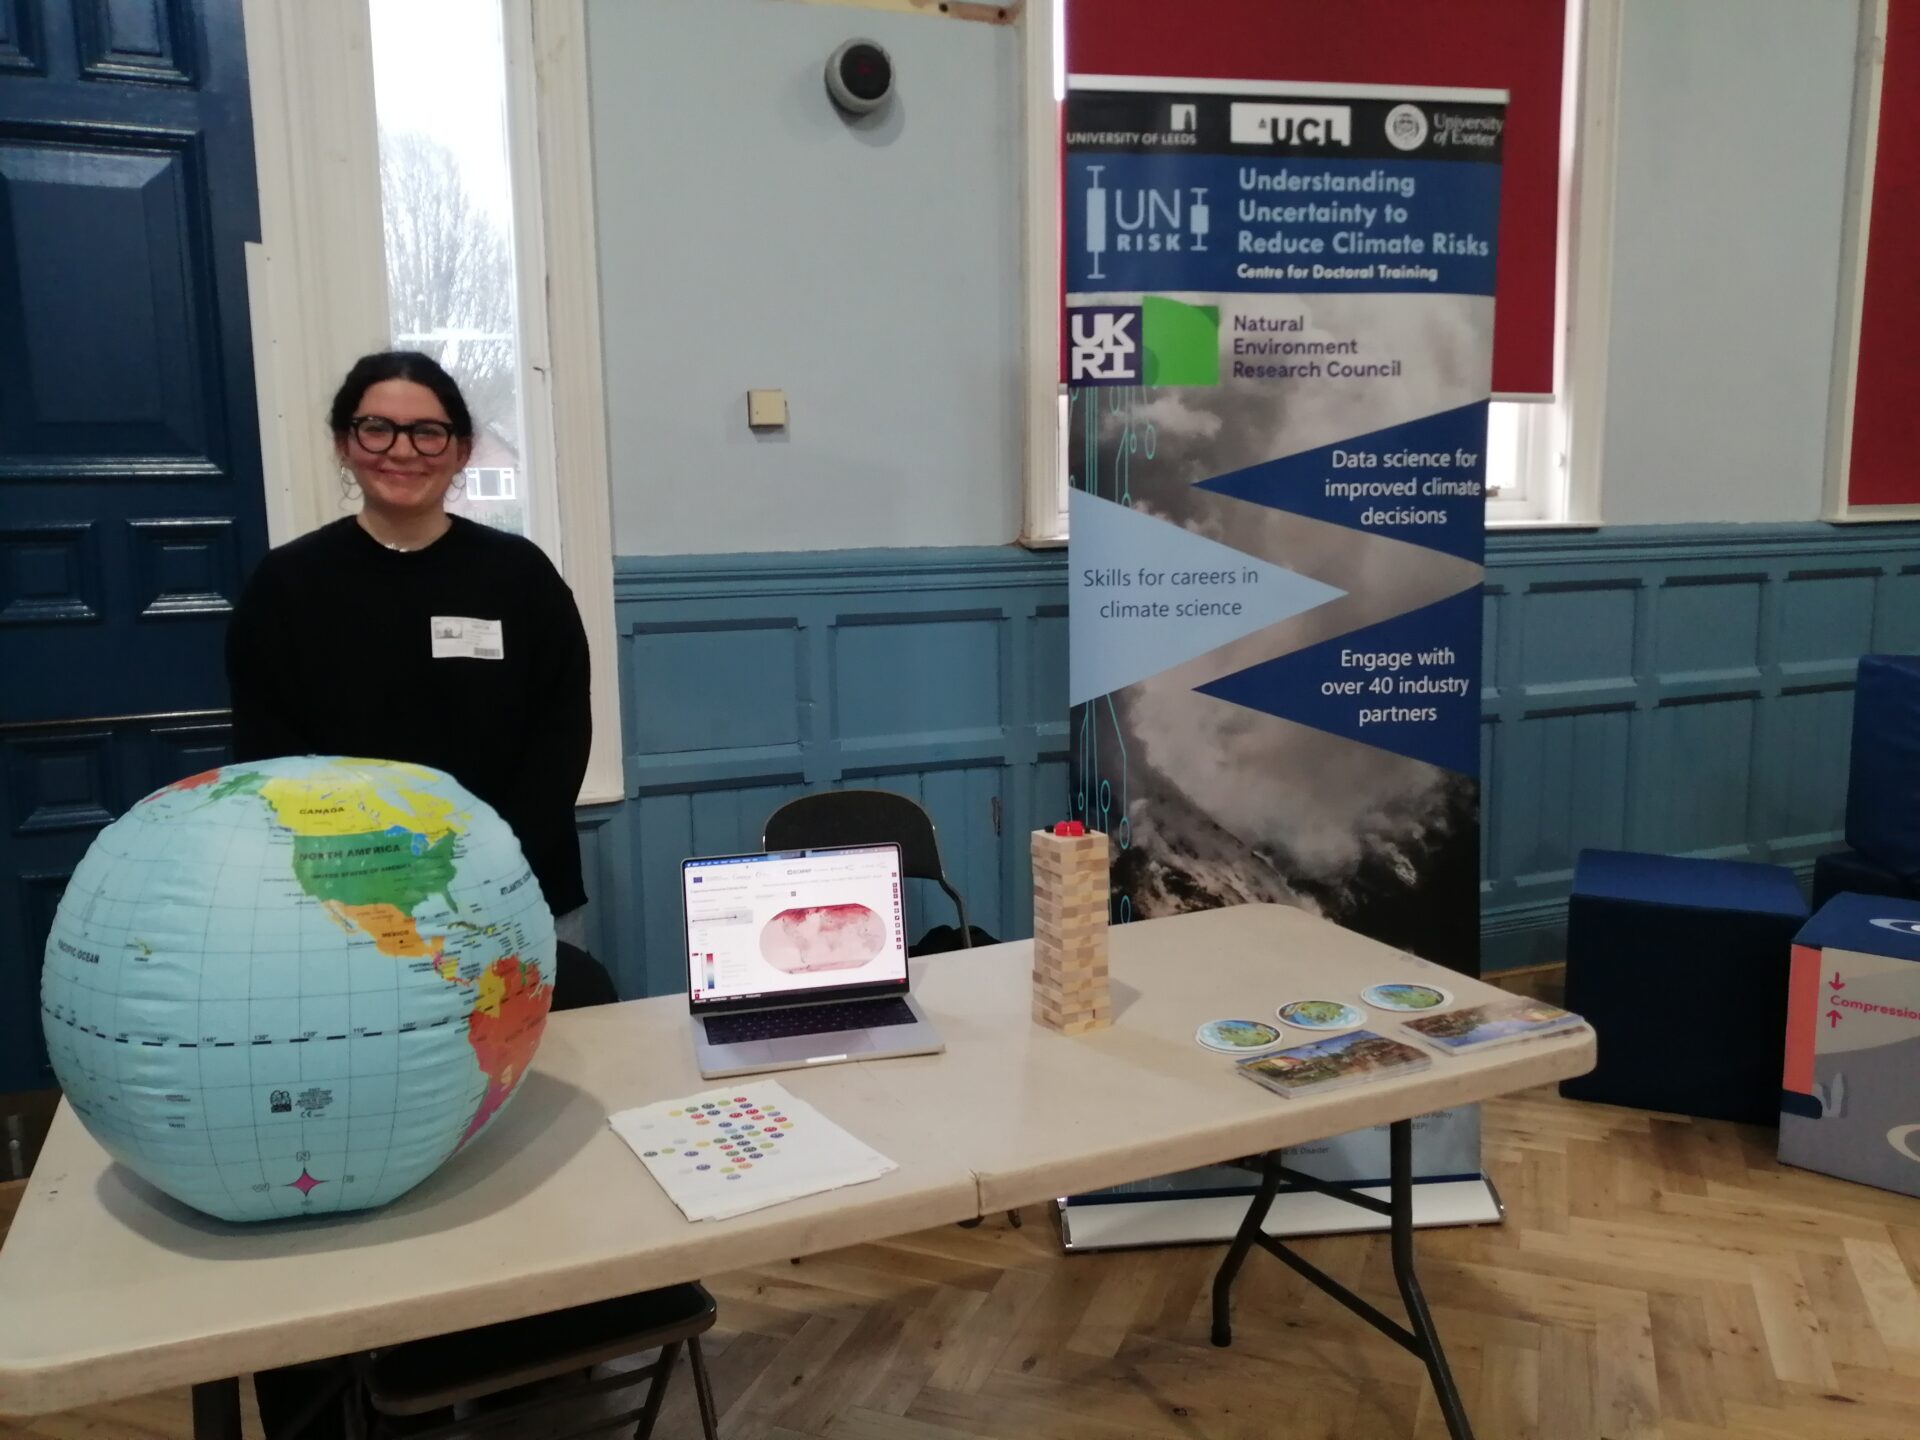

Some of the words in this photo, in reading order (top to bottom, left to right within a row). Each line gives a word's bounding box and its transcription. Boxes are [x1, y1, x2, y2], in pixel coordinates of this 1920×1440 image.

[1271, 117, 1342, 145] UCL
[1434, 112, 1503, 134] University
[1066, 131, 1139, 145] UNIVERSITY
[1141, 132, 1158, 145] OF
[1161, 132, 1197, 146] LEEDS
[1433, 131, 1448, 147] of
[1451, 128, 1496, 147] Exeter
[1239, 167, 1415, 198] Understanding
[1115, 188, 1180, 231] UN
[1239, 198, 1377, 229] Uncertainty
[1384, 203, 1408, 223] to
[1116, 233, 1181, 252] RISK
[1238, 230, 1324, 254] Reduce
[1332, 231, 1424, 254] Climate
[1432, 232, 1489, 256] Risks
[1236, 263, 1284, 279] Centre
[1286, 264, 1308, 280] for
[1312, 264, 1374, 280] Doctoral
[1378, 264, 1438, 282] Training
[1233, 315, 1304, 332] Natural
[1233, 338, 1358, 355] Environment
[1233, 361, 1321, 379] Research
[1327, 361, 1402, 378] Council
[1332, 450, 1378, 468] Data
[1383, 448, 1451, 468] science
[1455, 448, 1478, 468] for
[1325, 477, 1417, 501] improved
[1422, 476, 1482, 496] climate
[1360, 506, 1448, 526] decisions
[1083, 568, 1131, 587] Skills
[1138, 568, 1165, 586] for
[1170, 570, 1236, 585] careers
[1242, 566, 1258, 584] in
[1099, 600, 1170, 618] climate
[1175, 599, 1243, 617] science
[1341, 649, 1413, 672] Engage
[1417, 647, 1455, 666] with
[1321, 681, 1365, 696] over
[1368, 676, 1394, 695] 40
[1399, 675, 1470, 697] industry
[1359, 706, 1438, 727] partners
[299, 806, 345, 815] CANADA
[300, 850, 343, 861] NORTH
[346, 844, 401, 858] AMERICA
[77, 949, 100, 964] OCEAN
